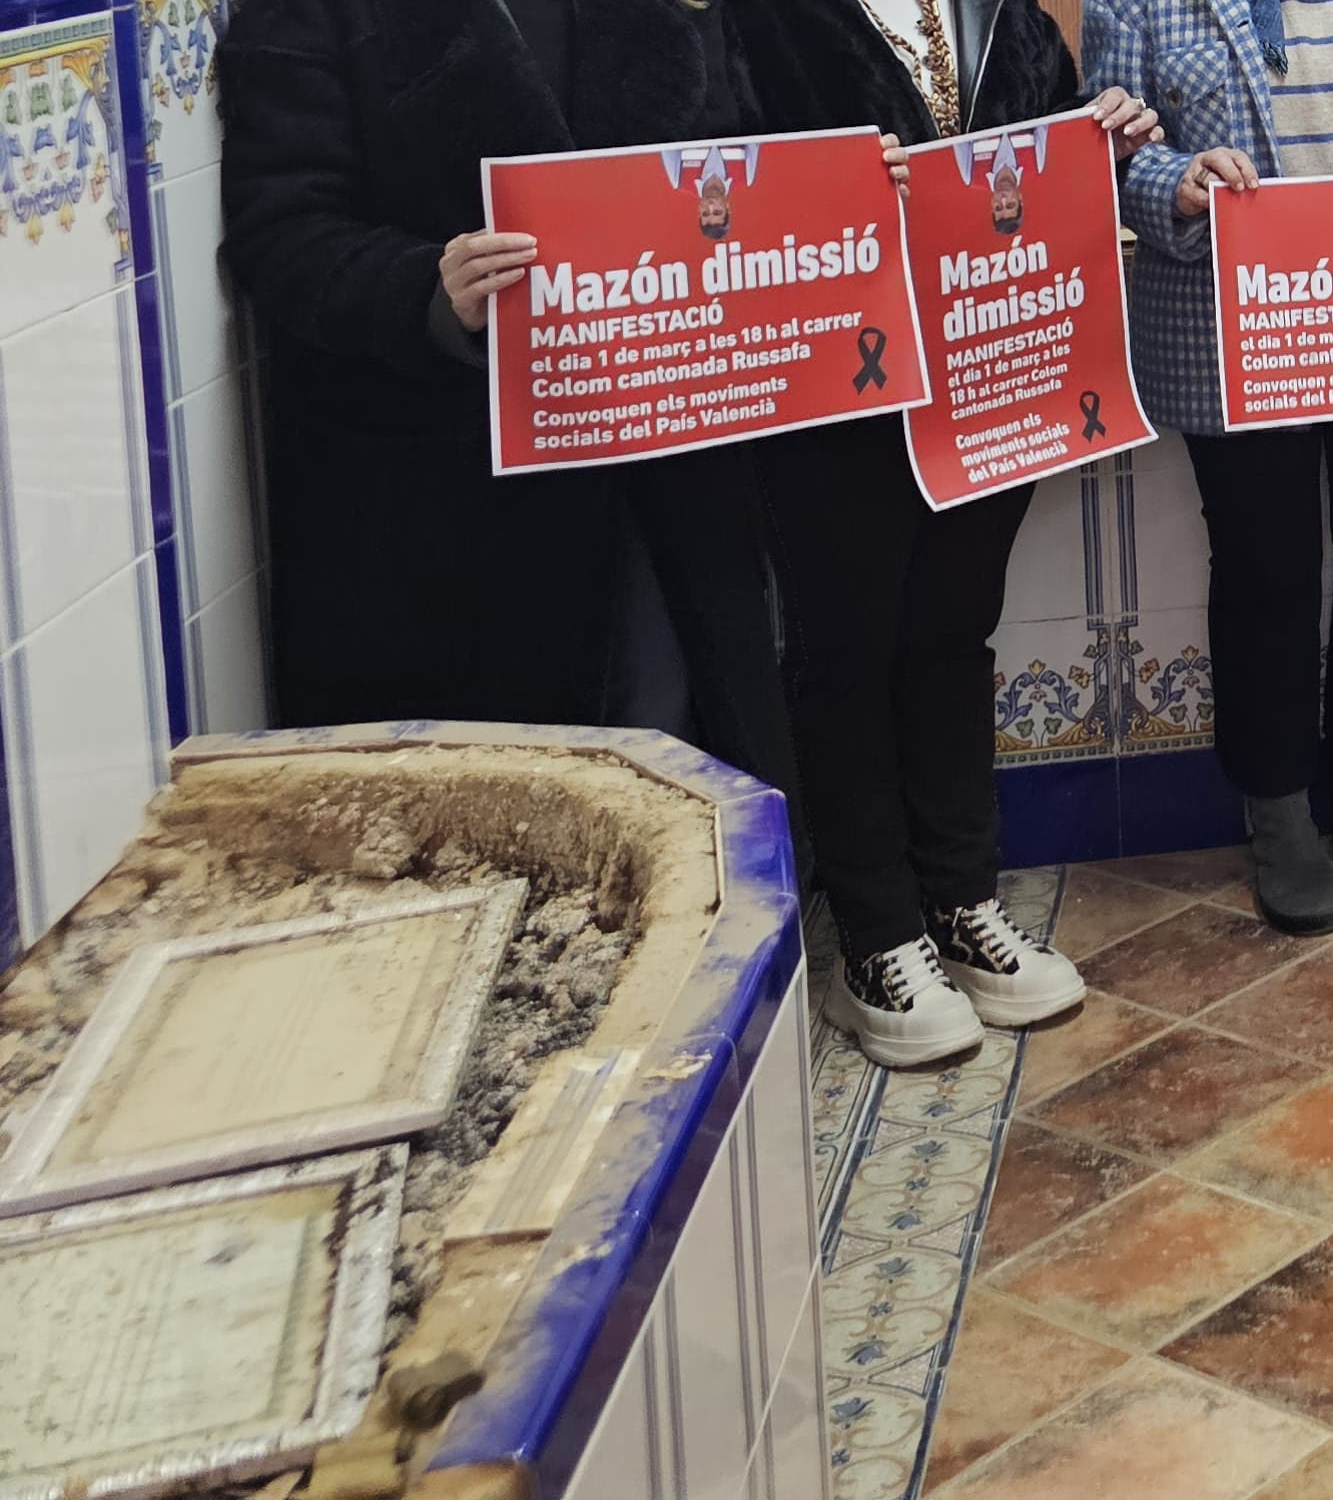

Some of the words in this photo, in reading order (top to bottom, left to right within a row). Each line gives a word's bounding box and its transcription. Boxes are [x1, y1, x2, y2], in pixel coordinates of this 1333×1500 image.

[531, 250, 688, 316] Mazón
[702, 223, 879, 294] dimissió
[940, 235, 1048, 295] Mazón
[531, 298, 723, 348] MANIFESTACIÓ
[943, 266, 1084, 342] dimissió
[531, 356, 553, 373] el
[558, 353, 592, 371] dia
[598, 350, 607, 367] 1
[614, 347, 639, 365] de
[643, 341, 691, 360] març
[695, 339, 706, 351] a
[710, 333, 737, 350] les
[741, 326, 762, 344] 18
[765, 324, 777, 340] h
[780, 317, 800, 338] al
[803, 311, 862, 335] carrer
[946, 316, 1073, 371] MANIFESTACIÓ
[1240, 337, 1255, 351] el
[1285, 333, 1292, 347] 1
[1297, 332, 1315, 346] de
[1242, 354, 1295, 371] Colom
[532, 377, 612, 398] Colom
[617, 356, 728, 390] cantonada
[732, 341, 811, 370] Russafa
[948, 372, 960, 388] el
[963, 370, 981, 383] dia
[985, 364, 990, 377] 1
[995, 360, 1008, 374] de
[1012, 353, 1040, 370] març
[1044, 350, 1050, 360] a
[1052, 344, 1070, 358] les
[950, 388, 965, 405] 18
[968, 386, 976, 400] h
[979, 383, 990, 397] al
[993, 374, 1029, 393] carrer
[1031, 363, 1068, 381] Colom
[1243, 376, 1325, 395] Convoquen
[533, 402, 652, 427] Convoquen
[656, 394, 686, 412] els
[690, 377, 788, 407] moviments
[951, 393, 1013, 420] cantonada
[1015, 378, 1062, 401] Russafa
[1245, 394, 1297, 413] socials
[1301, 390, 1325, 406] del
[534, 428, 614, 449] socials
[619, 420, 652, 439] del
[656, 413, 697, 433] País
[700, 397, 775, 425] Valencià
[956, 420, 1021, 450] Convoquen
[1023, 413, 1042, 429] els
[961, 436, 1028, 468] moviments
[1028, 423, 1070, 446] socials
[968, 465, 990, 484] del
[989, 457, 1017, 477] País
[1016, 441, 1069, 468] Valencià
